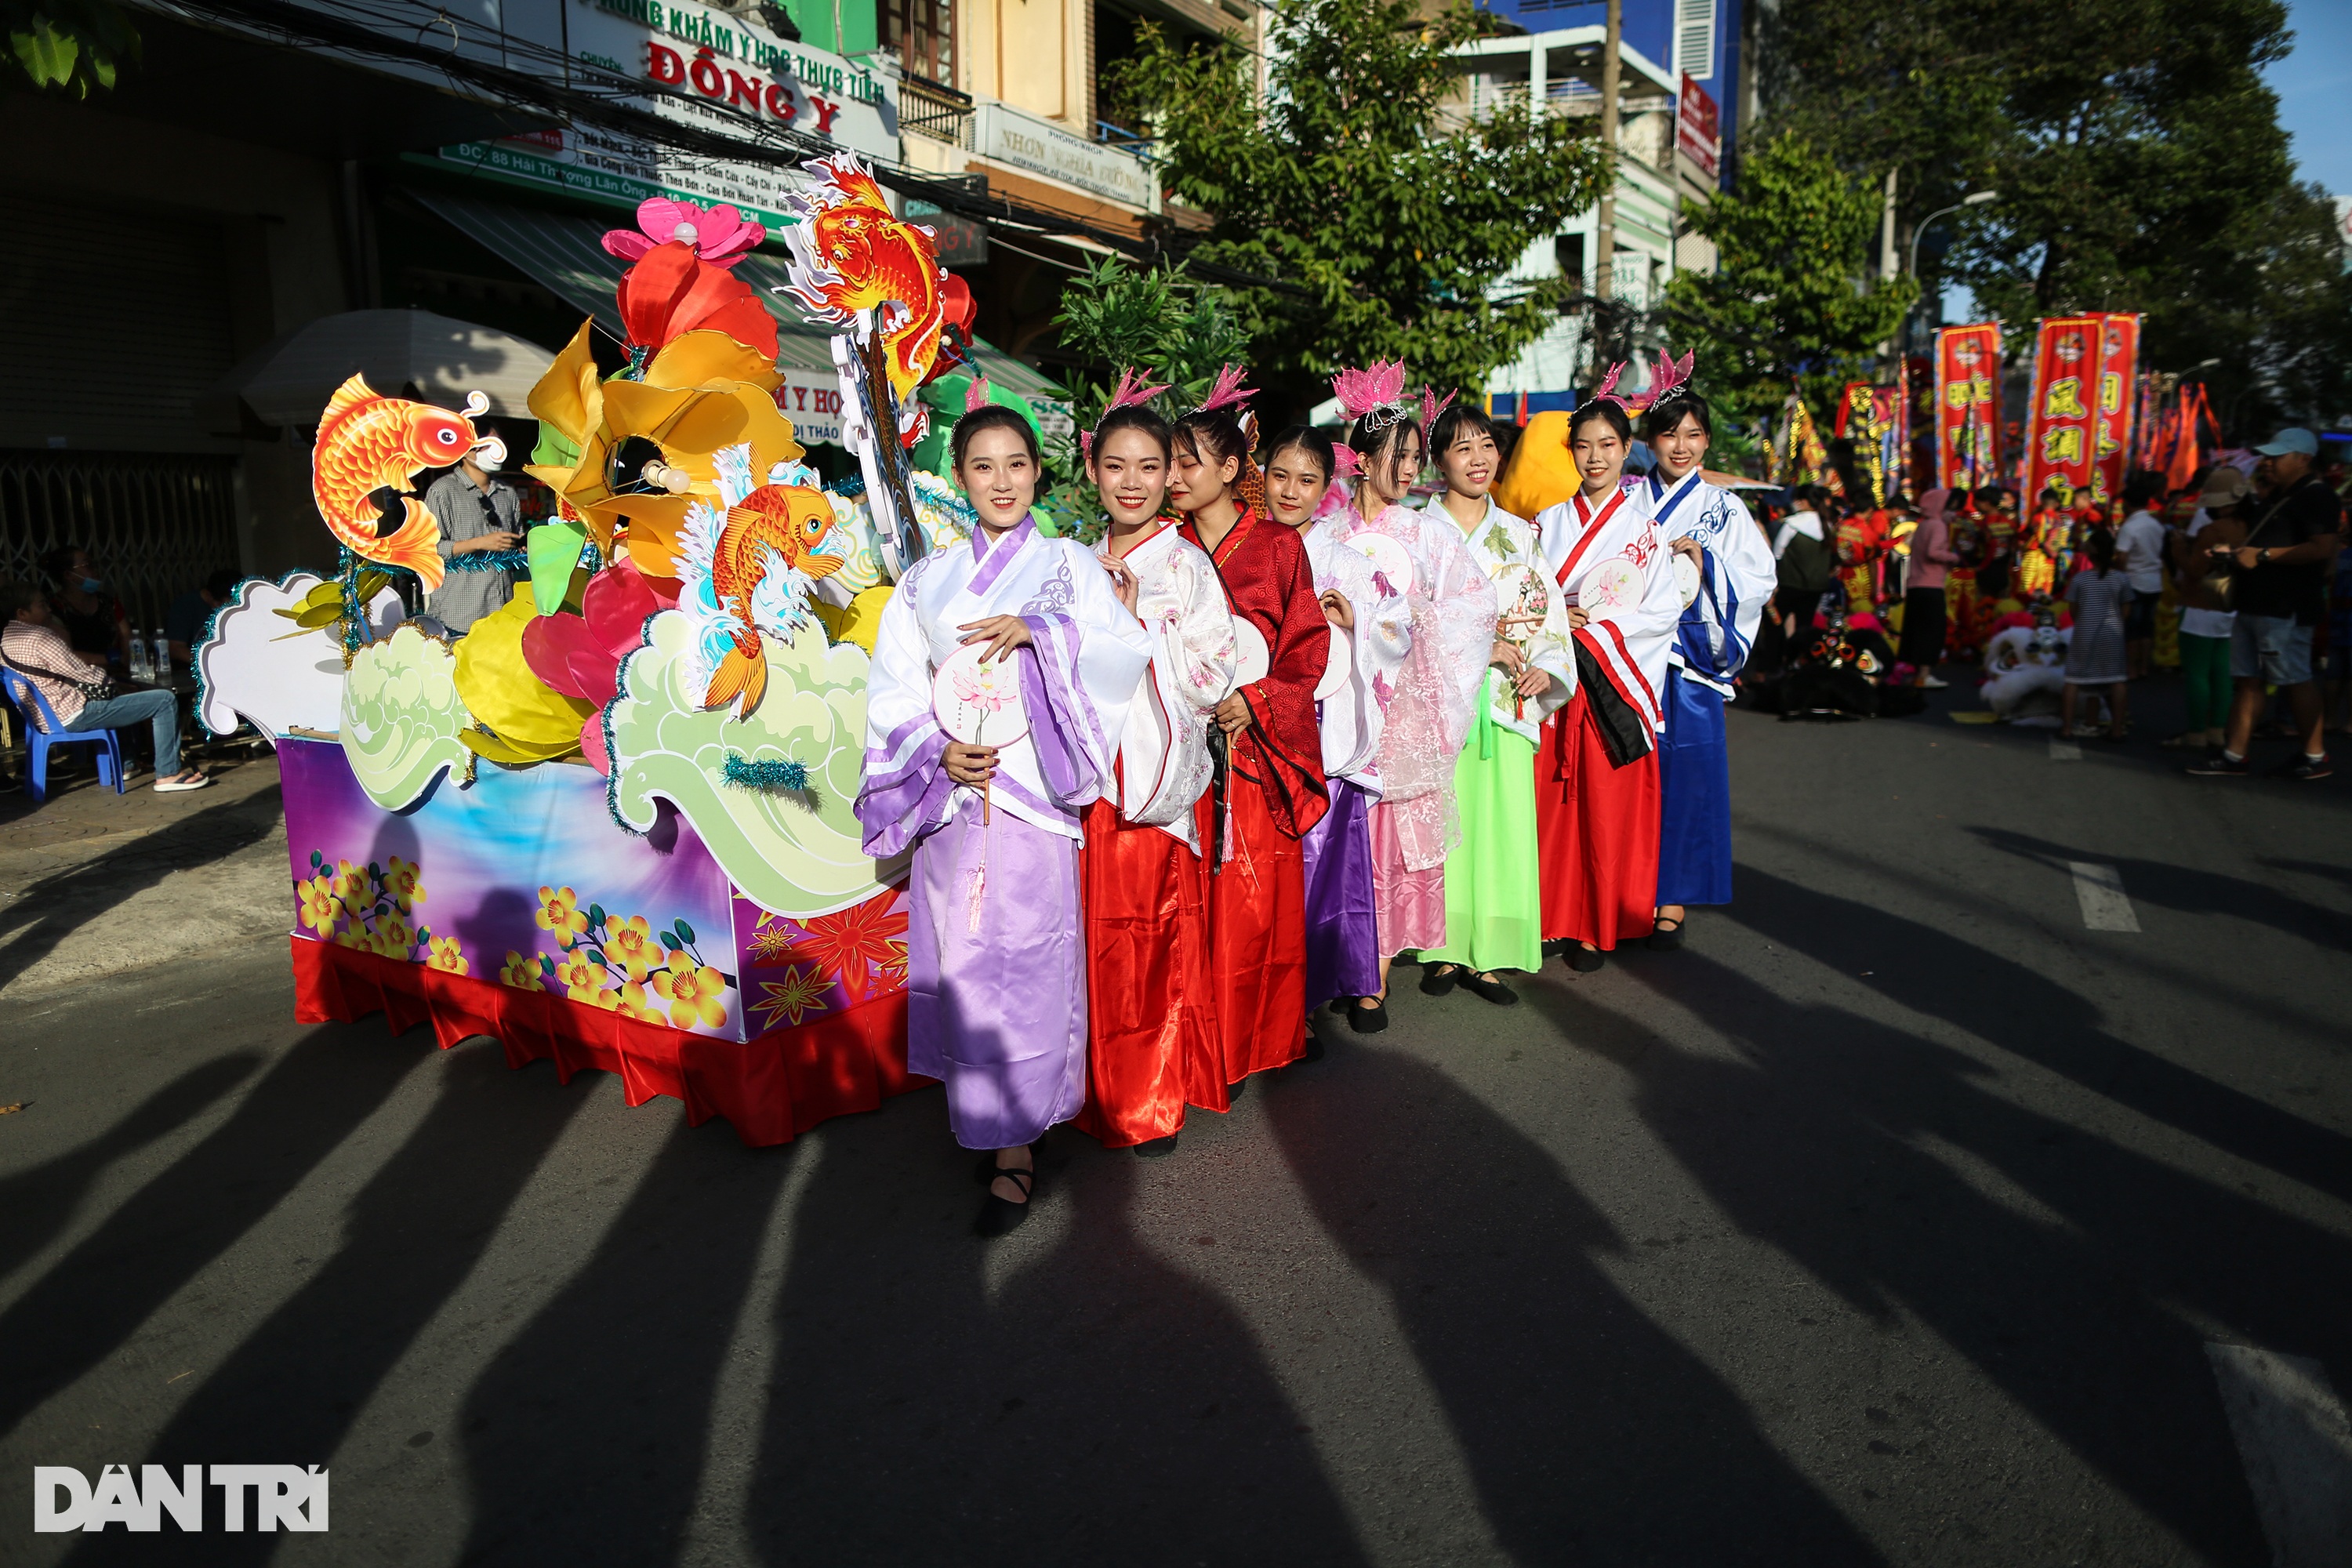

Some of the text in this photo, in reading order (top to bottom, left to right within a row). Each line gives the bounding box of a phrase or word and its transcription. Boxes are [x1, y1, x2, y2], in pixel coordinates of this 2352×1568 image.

[670, 10, 733, 53] KHÁM
[739, 33, 750, 57] Y
[647, 41, 797, 121] ĐÔNG
[809, 95, 840, 133] Y
[492, 151, 509, 165] 88
[539, 162, 592, 189] Thợng
[621, 180, 648, 200] Ông
[793, 387, 808, 412] Y
[813, 388, 841, 420] HỌ
[1030, 400, 1068, 415] 88
[808, 422, 839, 440] THẢO
